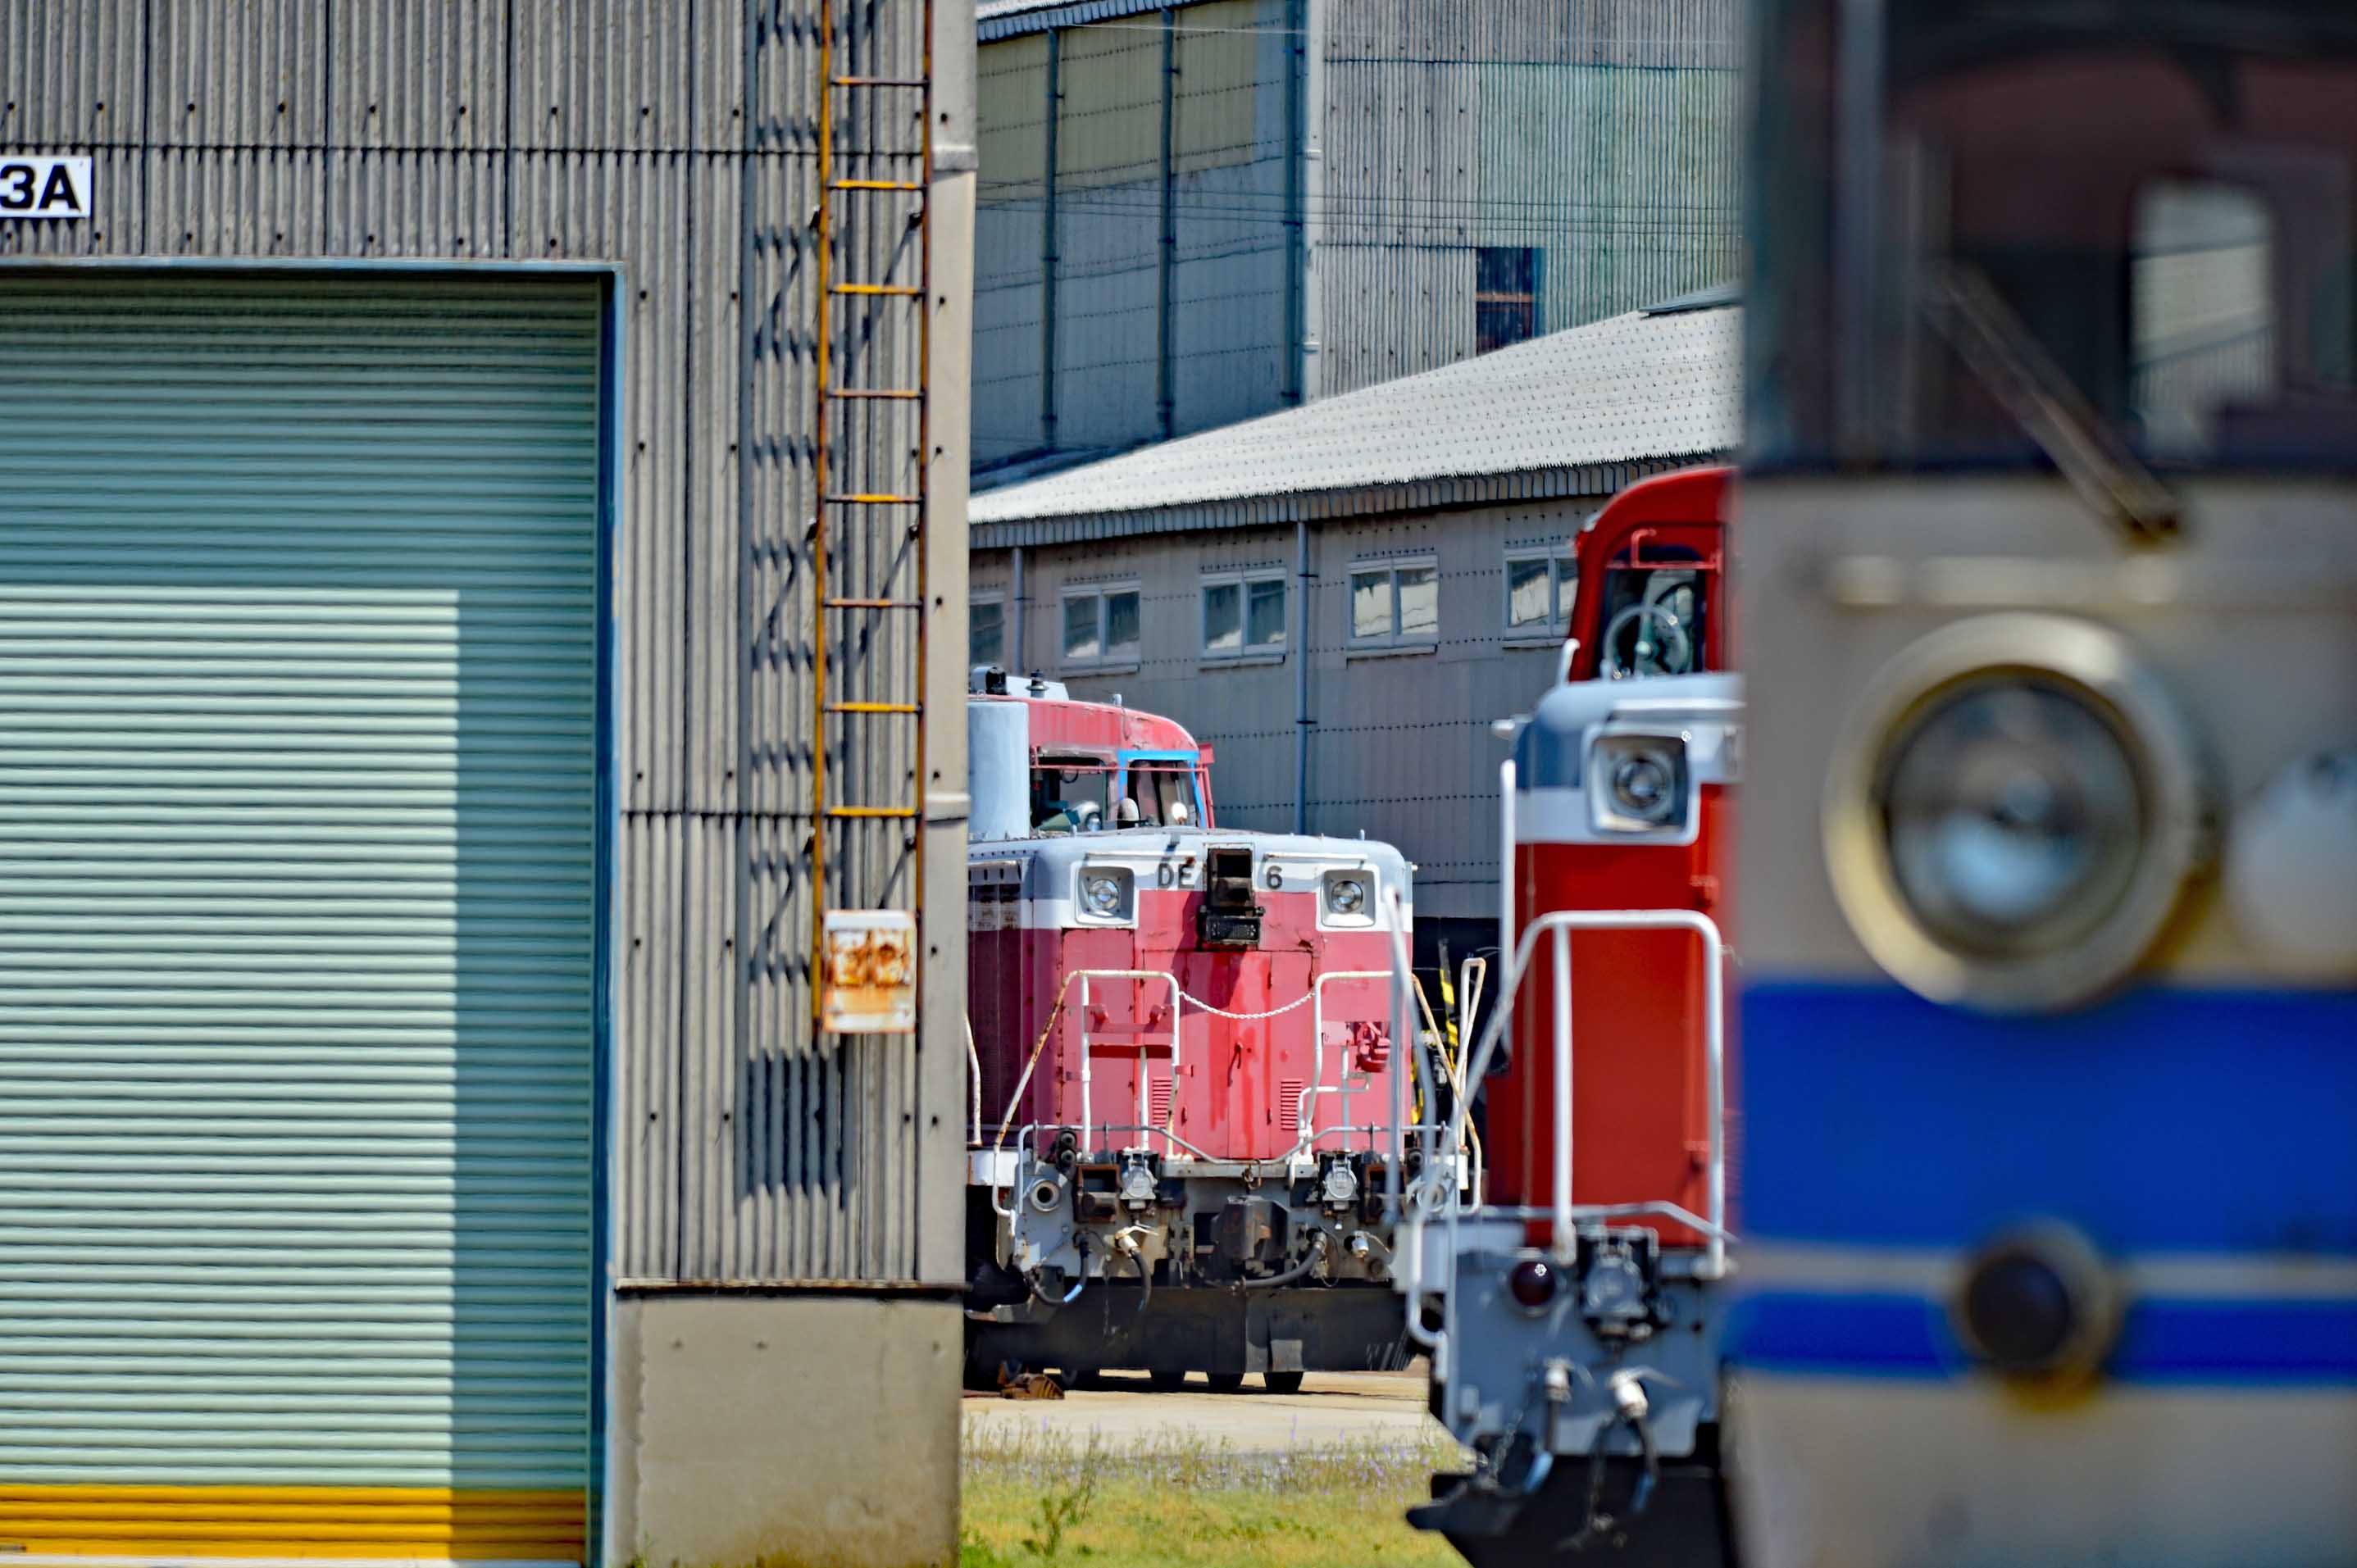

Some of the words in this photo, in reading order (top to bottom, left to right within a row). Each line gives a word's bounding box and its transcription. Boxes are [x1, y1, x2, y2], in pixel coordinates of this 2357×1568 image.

[0, 164, 80, 210] 3A
[1158, 862, 1194, 889] DE
[1266, 865, 1283, 889] 6
